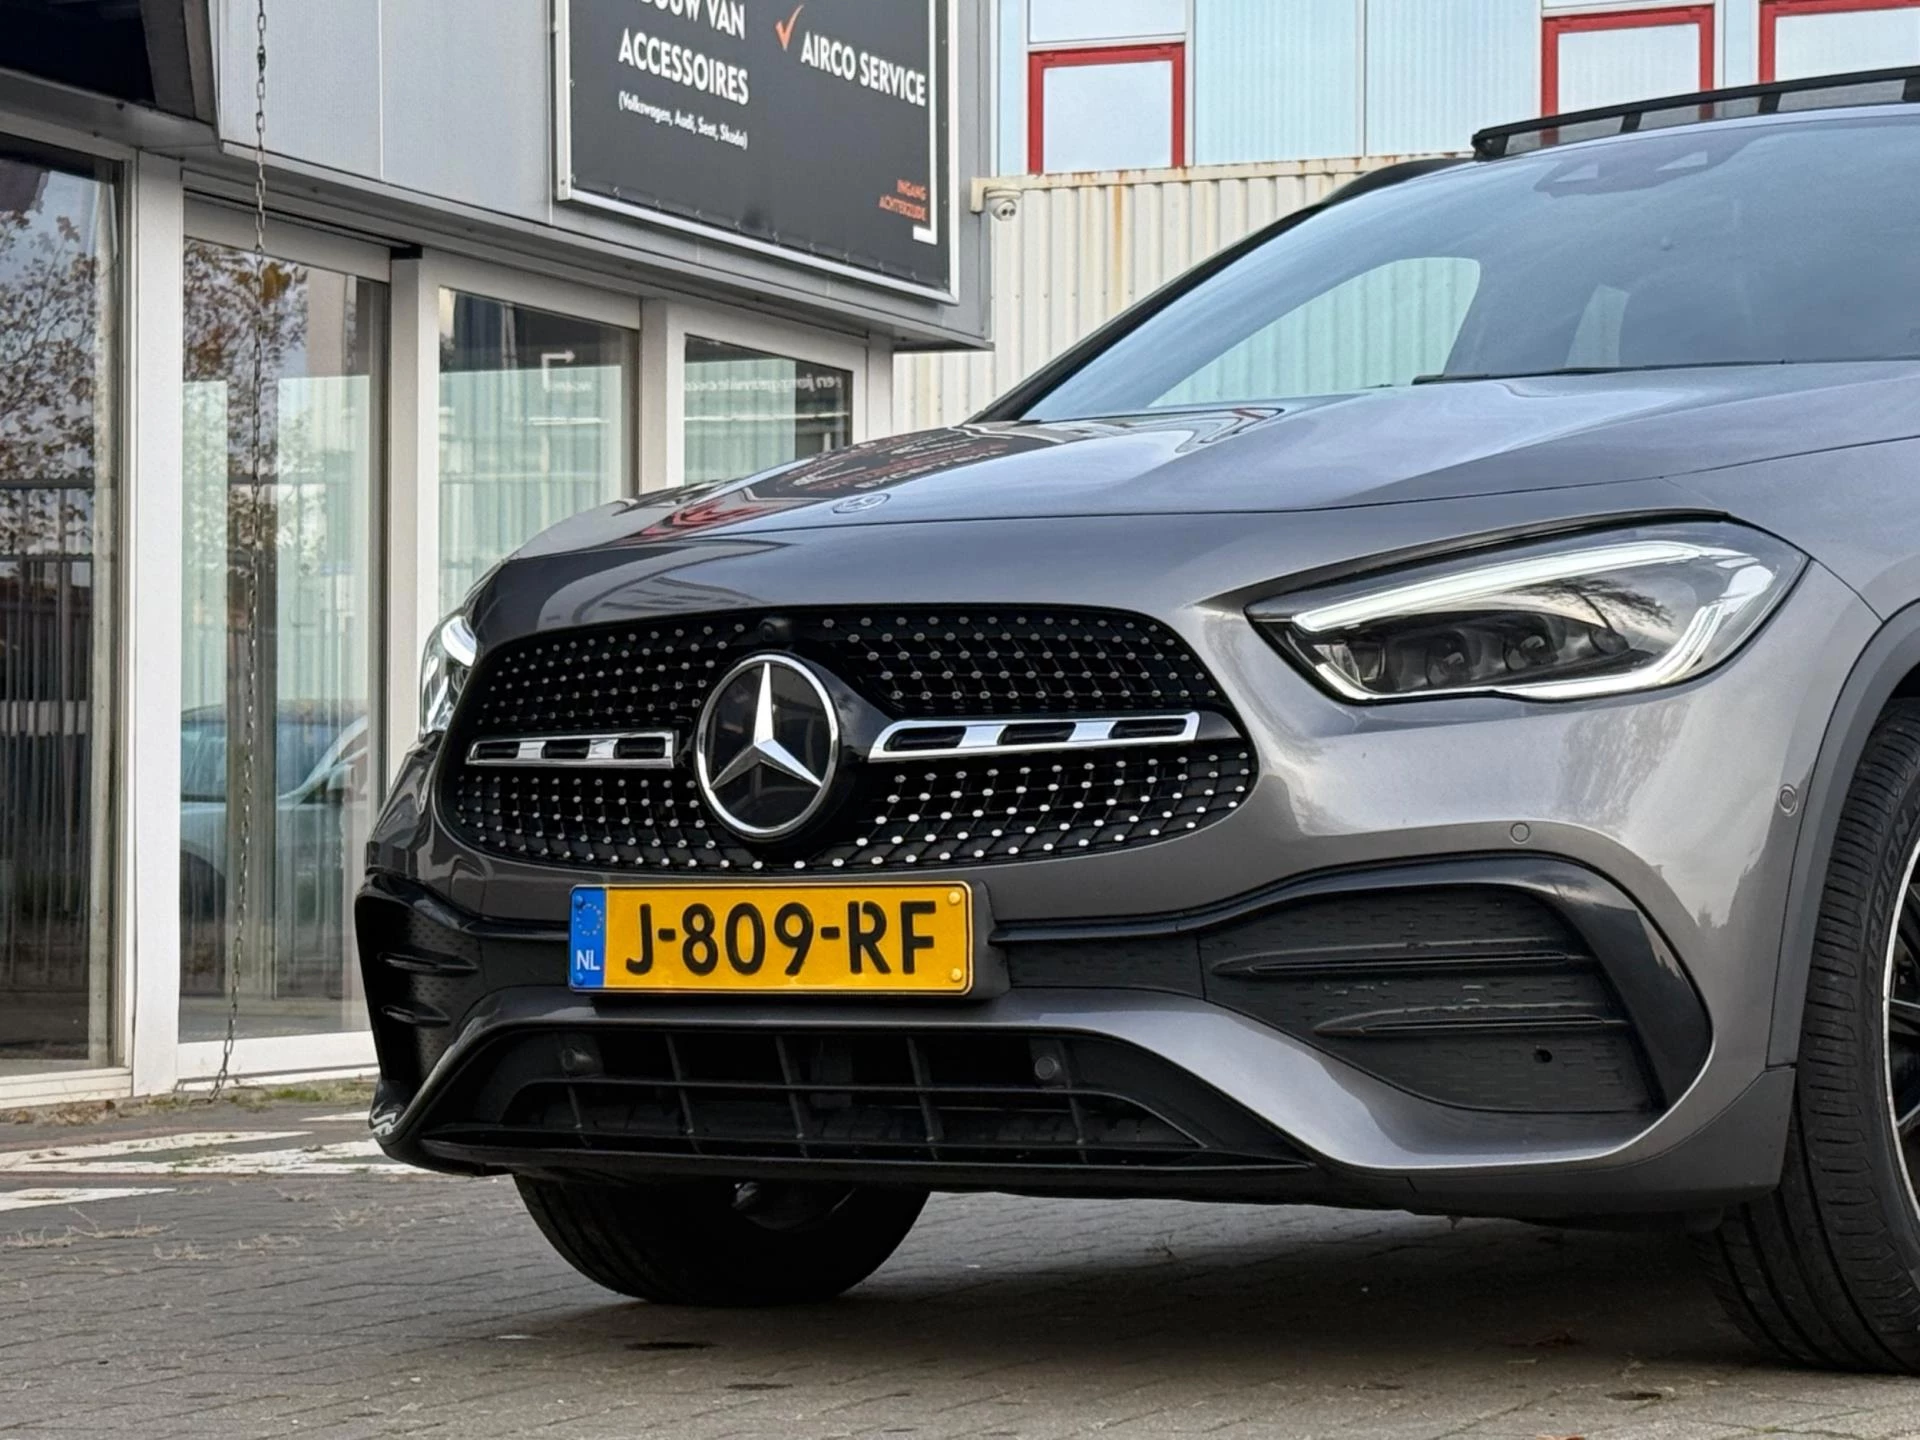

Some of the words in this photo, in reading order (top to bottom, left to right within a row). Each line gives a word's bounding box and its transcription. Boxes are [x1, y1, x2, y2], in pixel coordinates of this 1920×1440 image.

[706, 0, 745, 40] VAN
[618, 27, 749, 105] ACCESSOIRES
[801, 31, 856, 80] AIRCO
[860, 52, 926, 107] SERVICE
[577, 949, 601, 971] NL
[626, 901, 936, 976] J-809-RF
